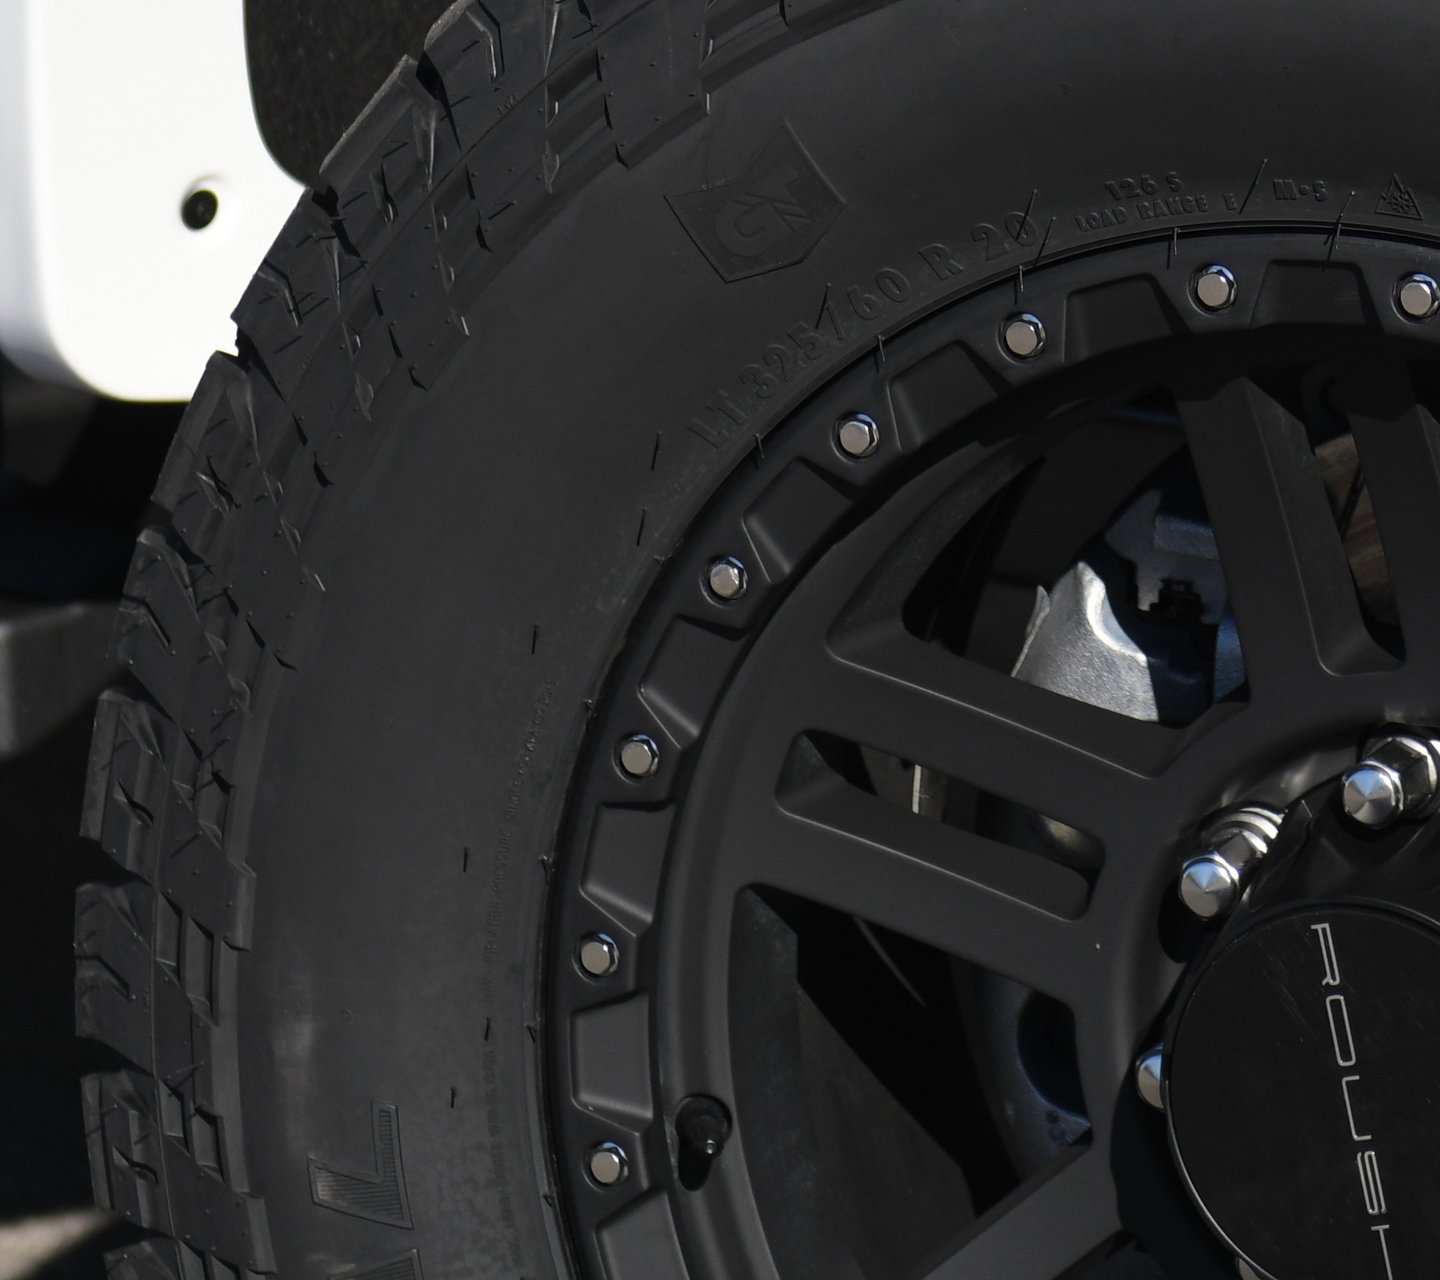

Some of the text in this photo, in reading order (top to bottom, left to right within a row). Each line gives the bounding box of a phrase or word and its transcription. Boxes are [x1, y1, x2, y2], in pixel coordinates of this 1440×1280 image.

[1104, 173, 1158, 202] 126
[1075, 203, 1128, 232] LOAD
[1137, 193, 1208, 220] RANGE
[970, 210, 1040, 262] 20
